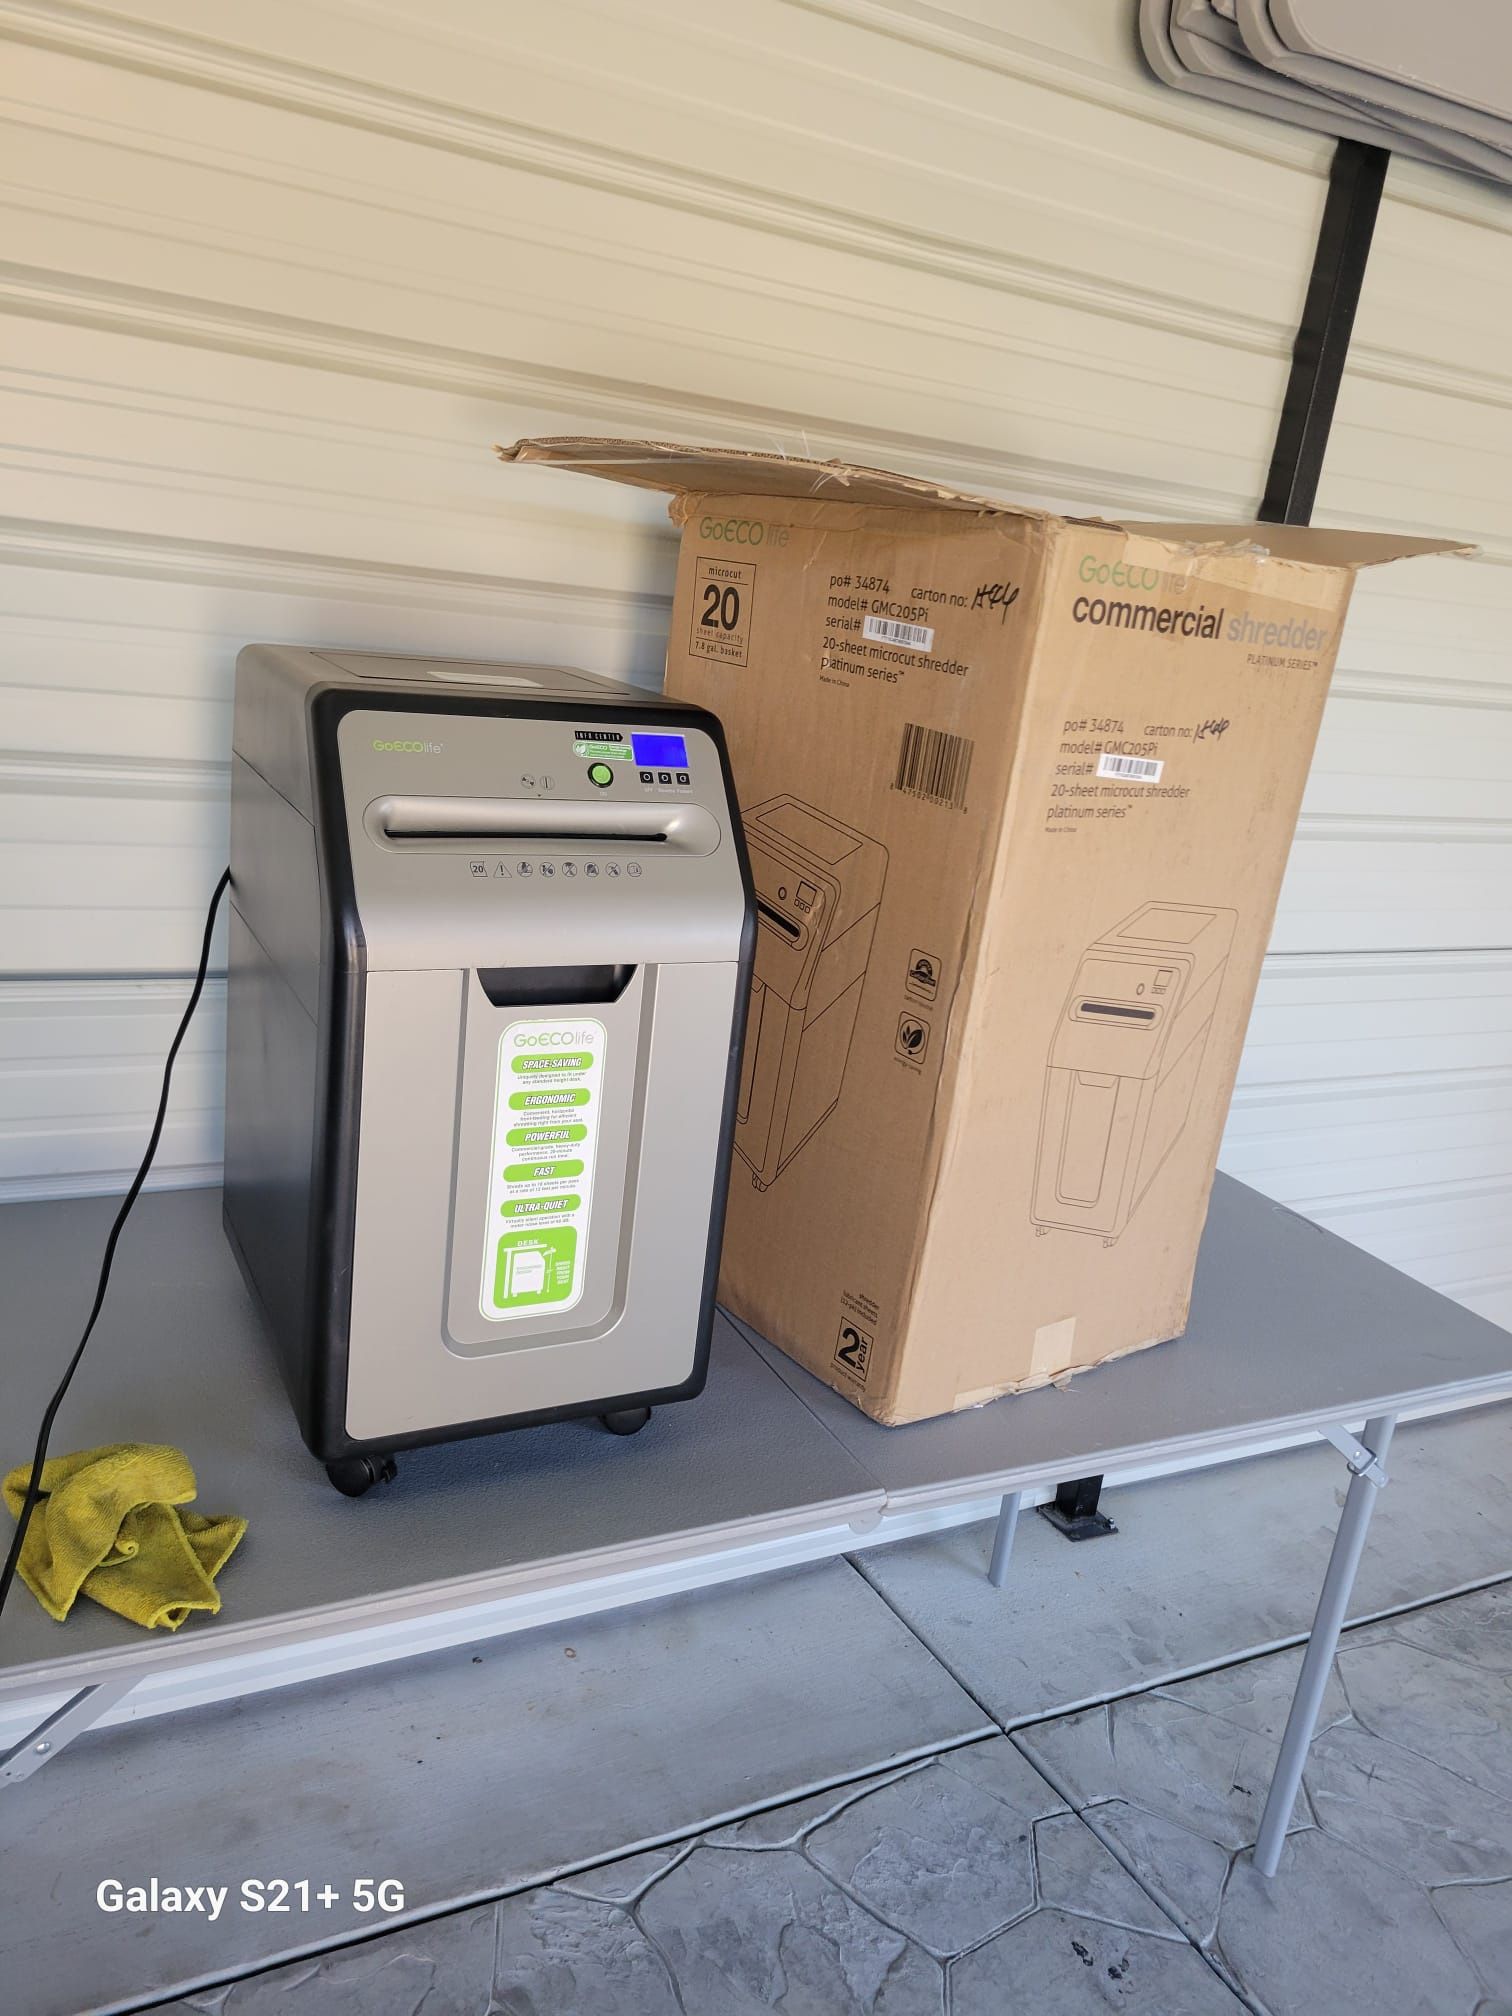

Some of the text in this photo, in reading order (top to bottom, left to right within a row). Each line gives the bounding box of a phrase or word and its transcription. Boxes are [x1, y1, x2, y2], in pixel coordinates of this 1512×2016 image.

[708, 567, 742, 579] microcut
[829, 575, 969, 608] po# 34874 carton no:
[701, 584, 740, 631] 20
[827, 595, 929, 622] model# GMC205Pi
[825, 615, 862, 632] serial#
[1072, 596, 1328, 651] commercial shredder
[695, 641, 705, 650] 7.8
[720, 647, 743, 658] basket
[822, 636, 868, 657] 20-sheet
[869, 645, 916, 667] microcut
[917, 654, 969, 677] shredder
[820, 656, 865, 677] platinum
[1246, 653, 1286, 667] PLATINUM
[1062, 719, 1088, 736] po#
[1088, 718, 1125, 733] 34874
[1143, 725, 1176, 737] carton
[1059, 740, 1159, 757] model# GMC205Pi
[1055, 761, 1094, 776] serial#
[1050, 782, 1191, 798] 20-sheet microcut shredder
[1046, 804, 1095, 822] platinum
[472, 865, 484, 874] 20
[522, 1057, 582, 1070] SPACE-SAVING
[524, 1093, 577, 1106] ERGONOMIC
[524, 1130, 571, 1142] POWERFUL
[533, 1166, 556, 1177] FAST
[514, 1199, 569, 1214] ULTRA-QUIET
[838, 1327, 869, 1374] 2 year
